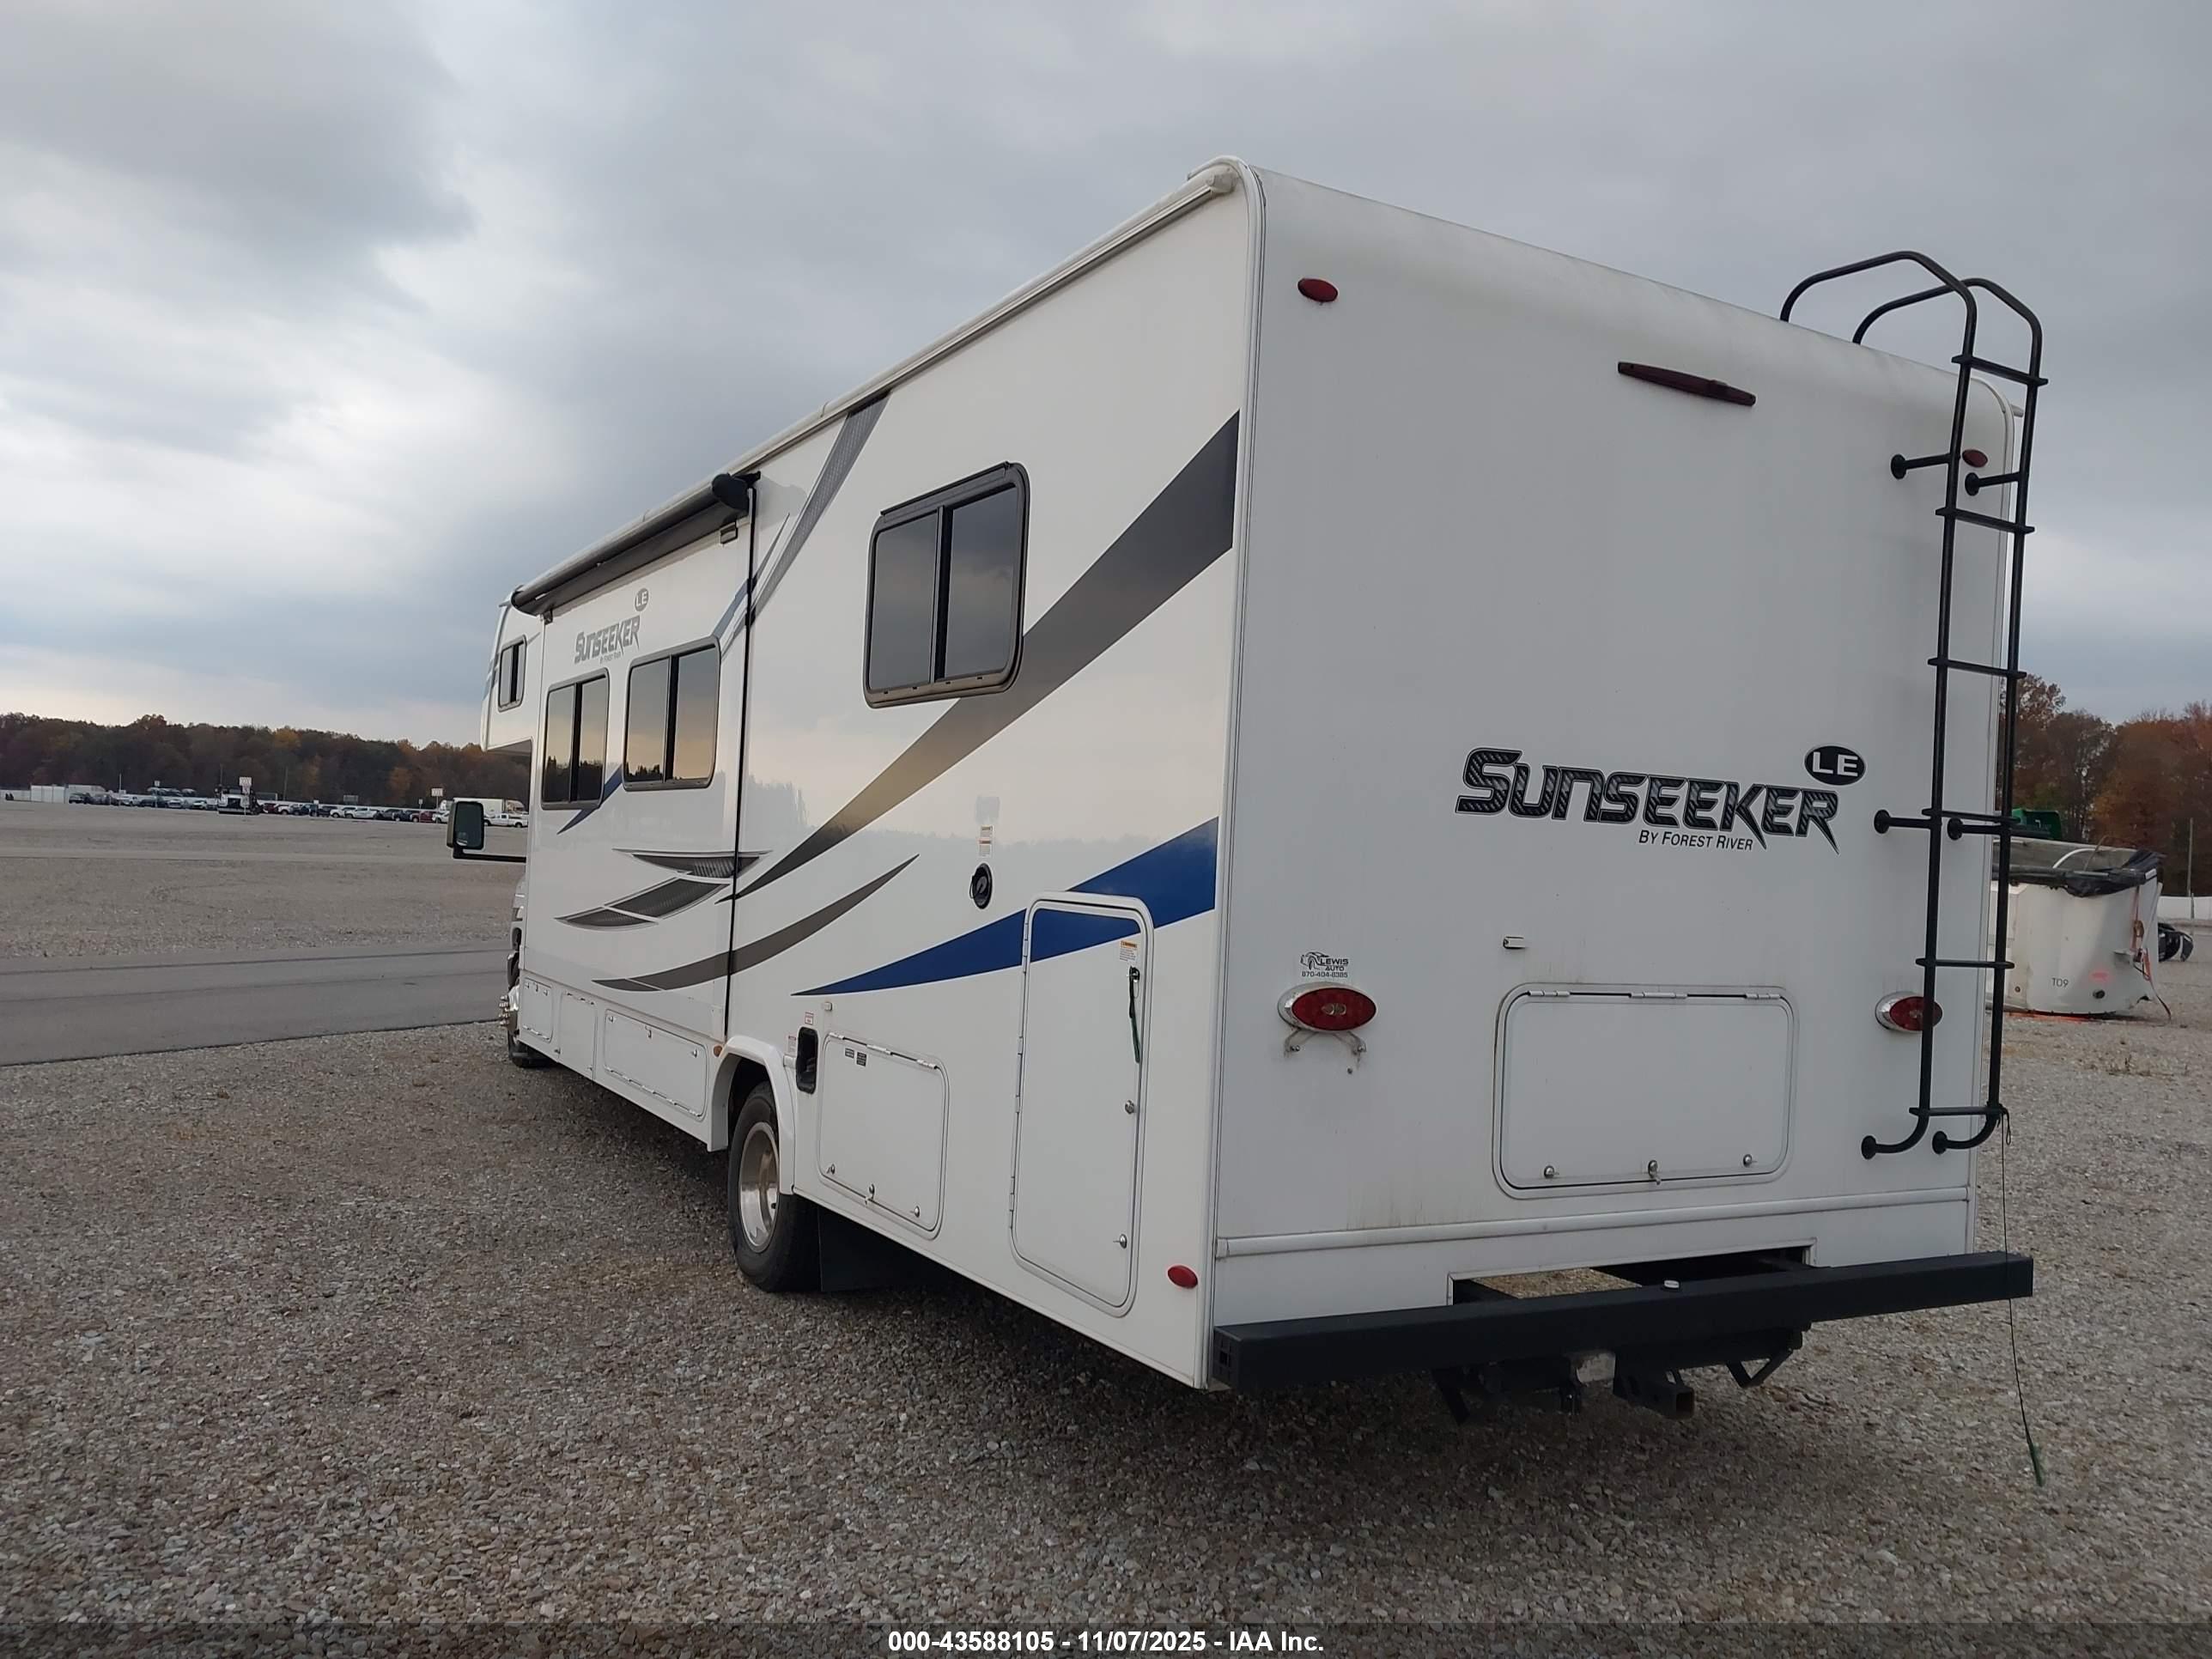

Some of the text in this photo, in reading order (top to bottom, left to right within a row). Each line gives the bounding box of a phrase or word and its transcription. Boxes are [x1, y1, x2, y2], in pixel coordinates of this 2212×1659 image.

[1812, 751, 1858, 776] LE
[1455, 747, 1839, 854] SUNSEEKER
[1638, 830, 1753, 850] BY FOREST RIVER
